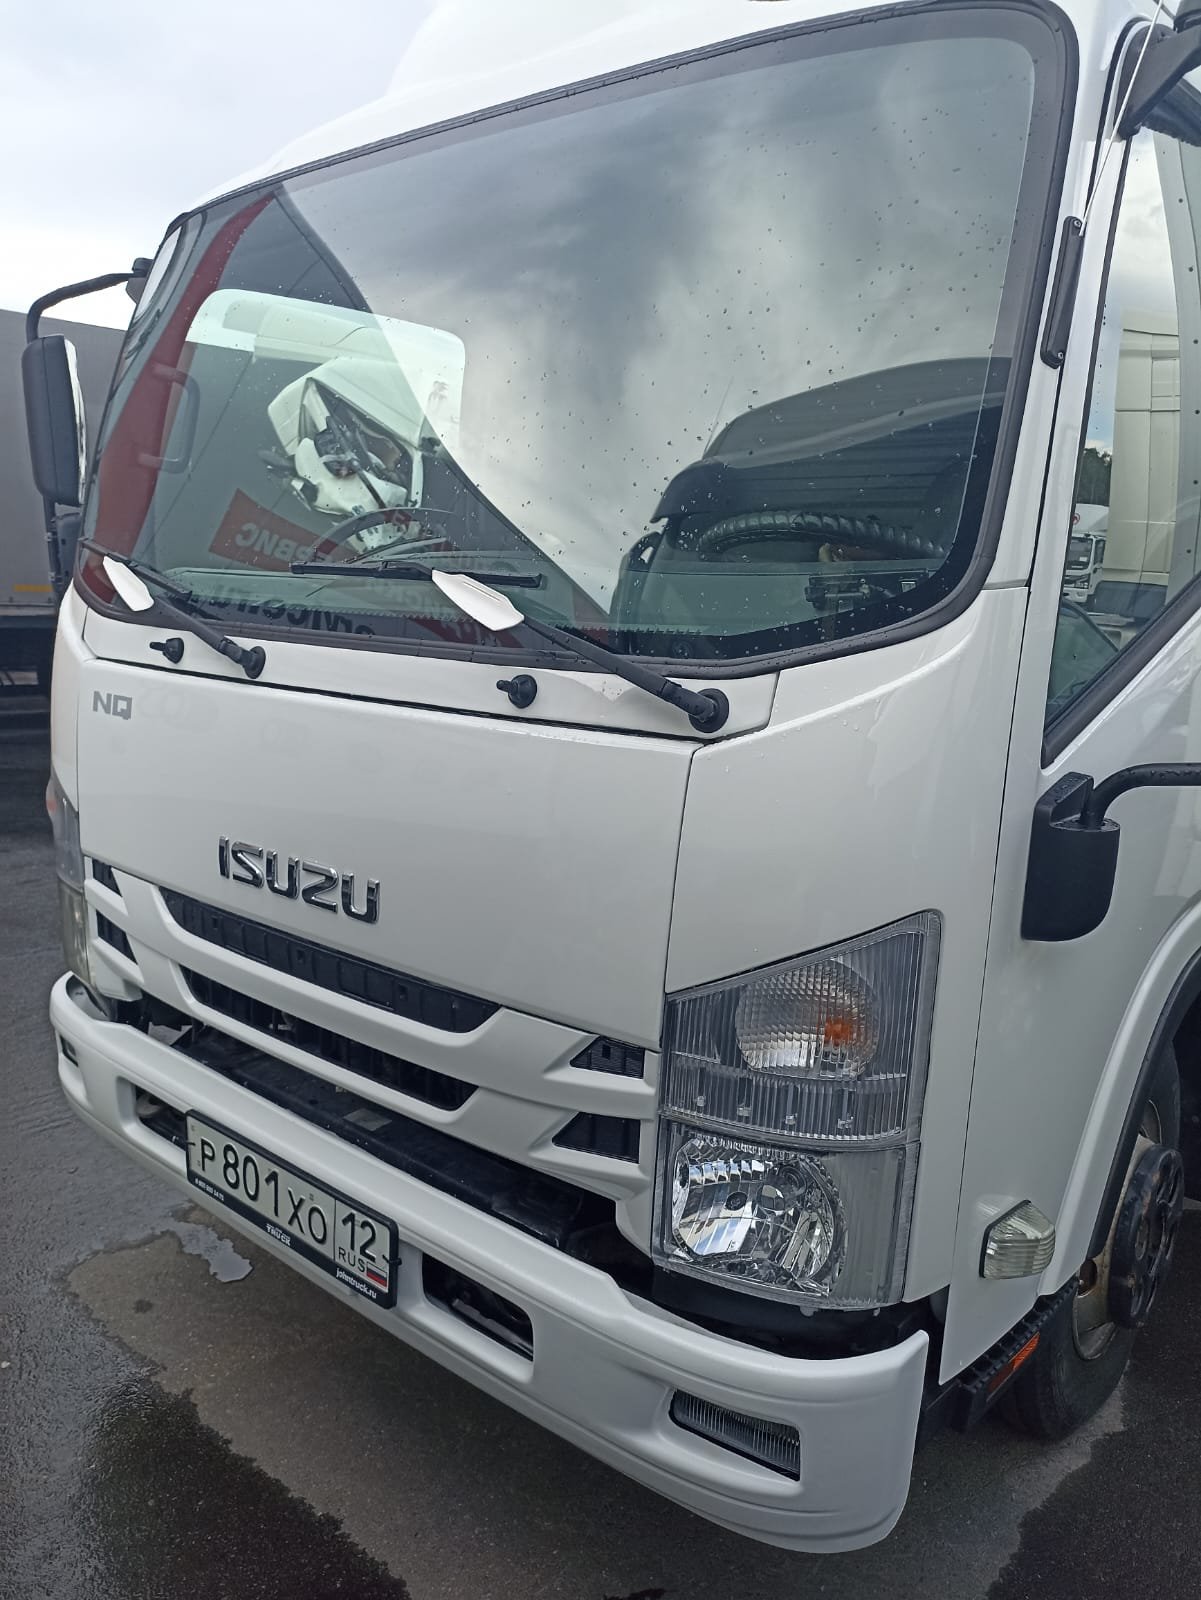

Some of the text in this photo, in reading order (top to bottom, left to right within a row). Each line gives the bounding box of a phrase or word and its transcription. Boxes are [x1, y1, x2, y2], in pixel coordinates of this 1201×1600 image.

[217, 835, 381, 924] ISUZU
[338, 1247, 366, 1273] RUS
[341, 1211, 377, 1263] 12
